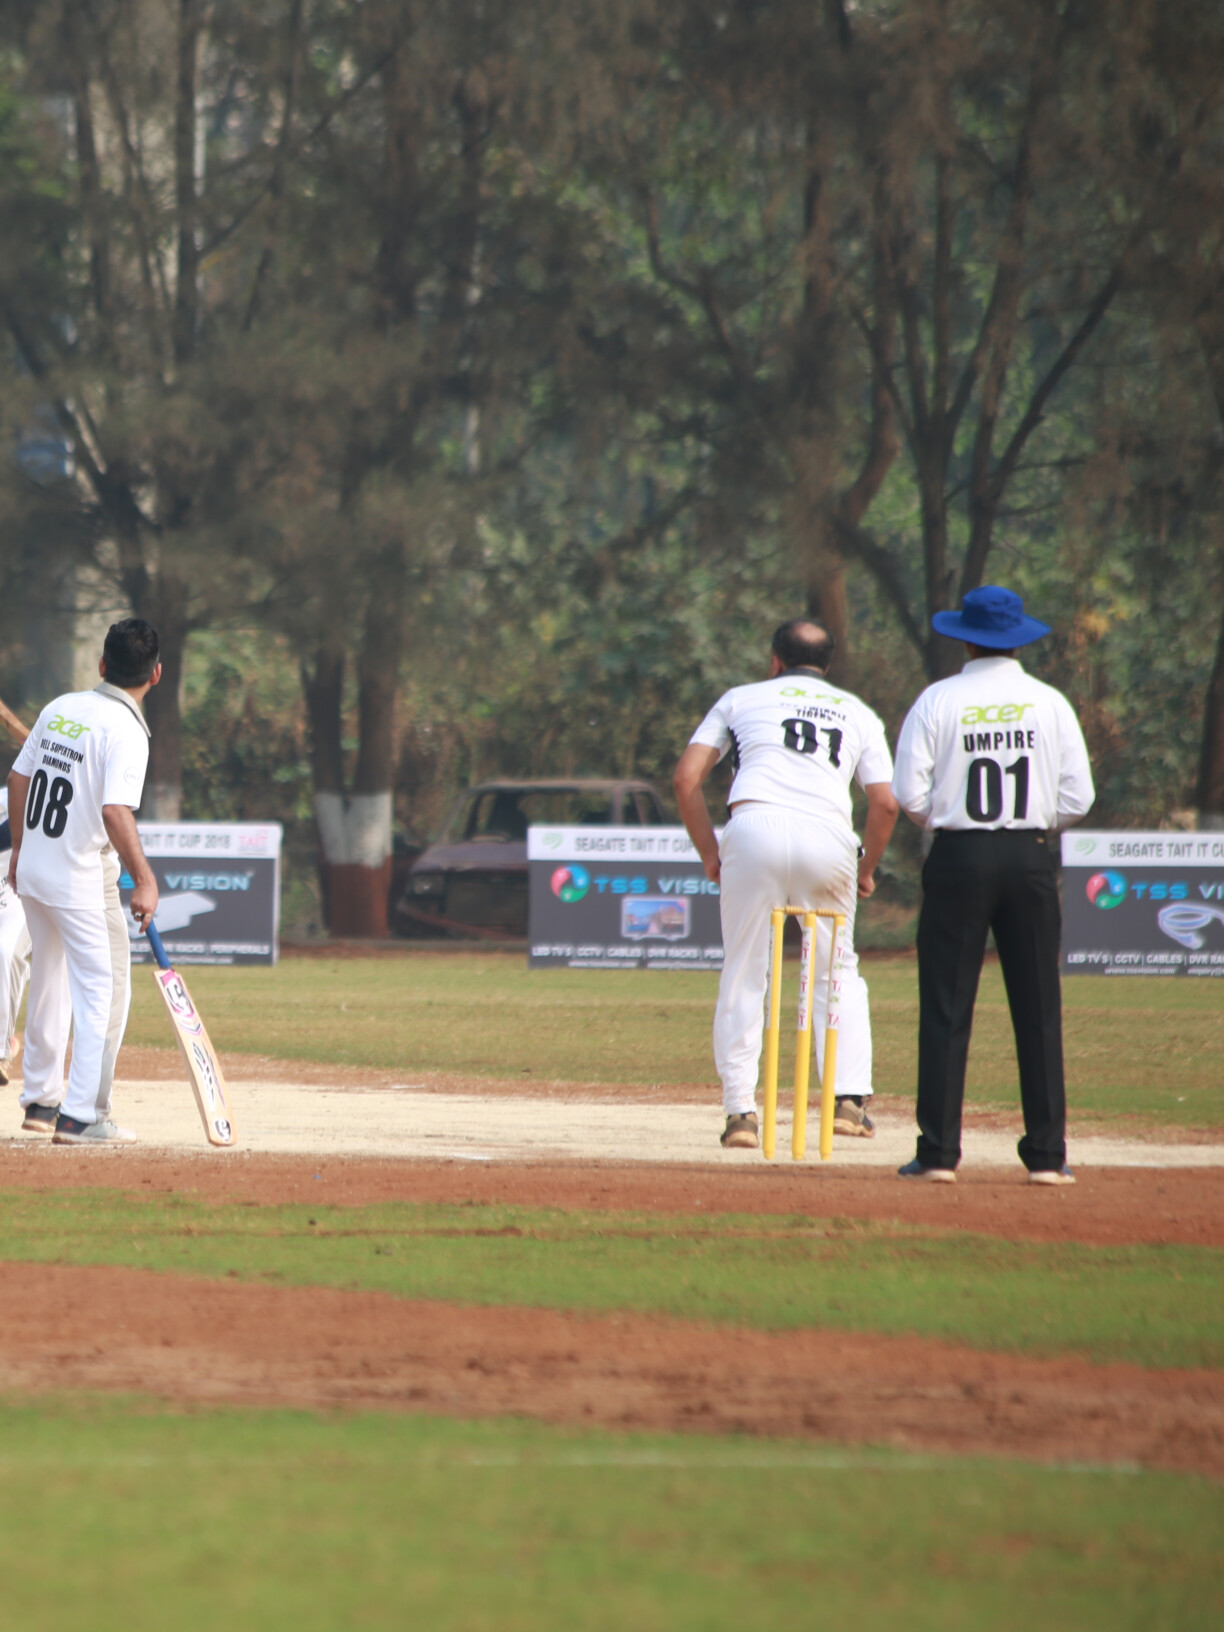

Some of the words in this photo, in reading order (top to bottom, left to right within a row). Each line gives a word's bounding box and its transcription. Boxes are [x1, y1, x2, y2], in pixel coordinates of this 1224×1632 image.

[961, 703, 1034, 725] acer
[47, 714, 91, 740] acer
[963, 730, 1035, 753] UMPIRE
[50, 742, 84, 764] SUPERTRON
[42, 754, 72, 774] DIAMONDS
[965, 756, 1029, 823] 01
[26, 769, 73, 838] 08
[165, 834, 176, 848] IT
[179, 834, 201, 849] CUP
[575, 837, 626, 852] SEAGATE
[630, 837, 654, 852] TAIT
[657, 837, 669, 852] IT
[1109, 842, 1163, 858] SEAGATE
[1167, 842, 1193, 858] TAIT
[1197, 842, 1208, 858] IT
[1212, 842, 1224, 858] CU
[164, 870, 250, 891] VISION
[593, 876, 649, 894] TSS
[657, 876, 721, 896] VISIO
[1131, 881, 1189, 900] TSS
[1067, 953, 1085, 964] LED
[1114, 953, 1142, 964] CCTV
[1146, 953, 1183, 965] CABLES
[1189, 953, 1208, 965] DVR
